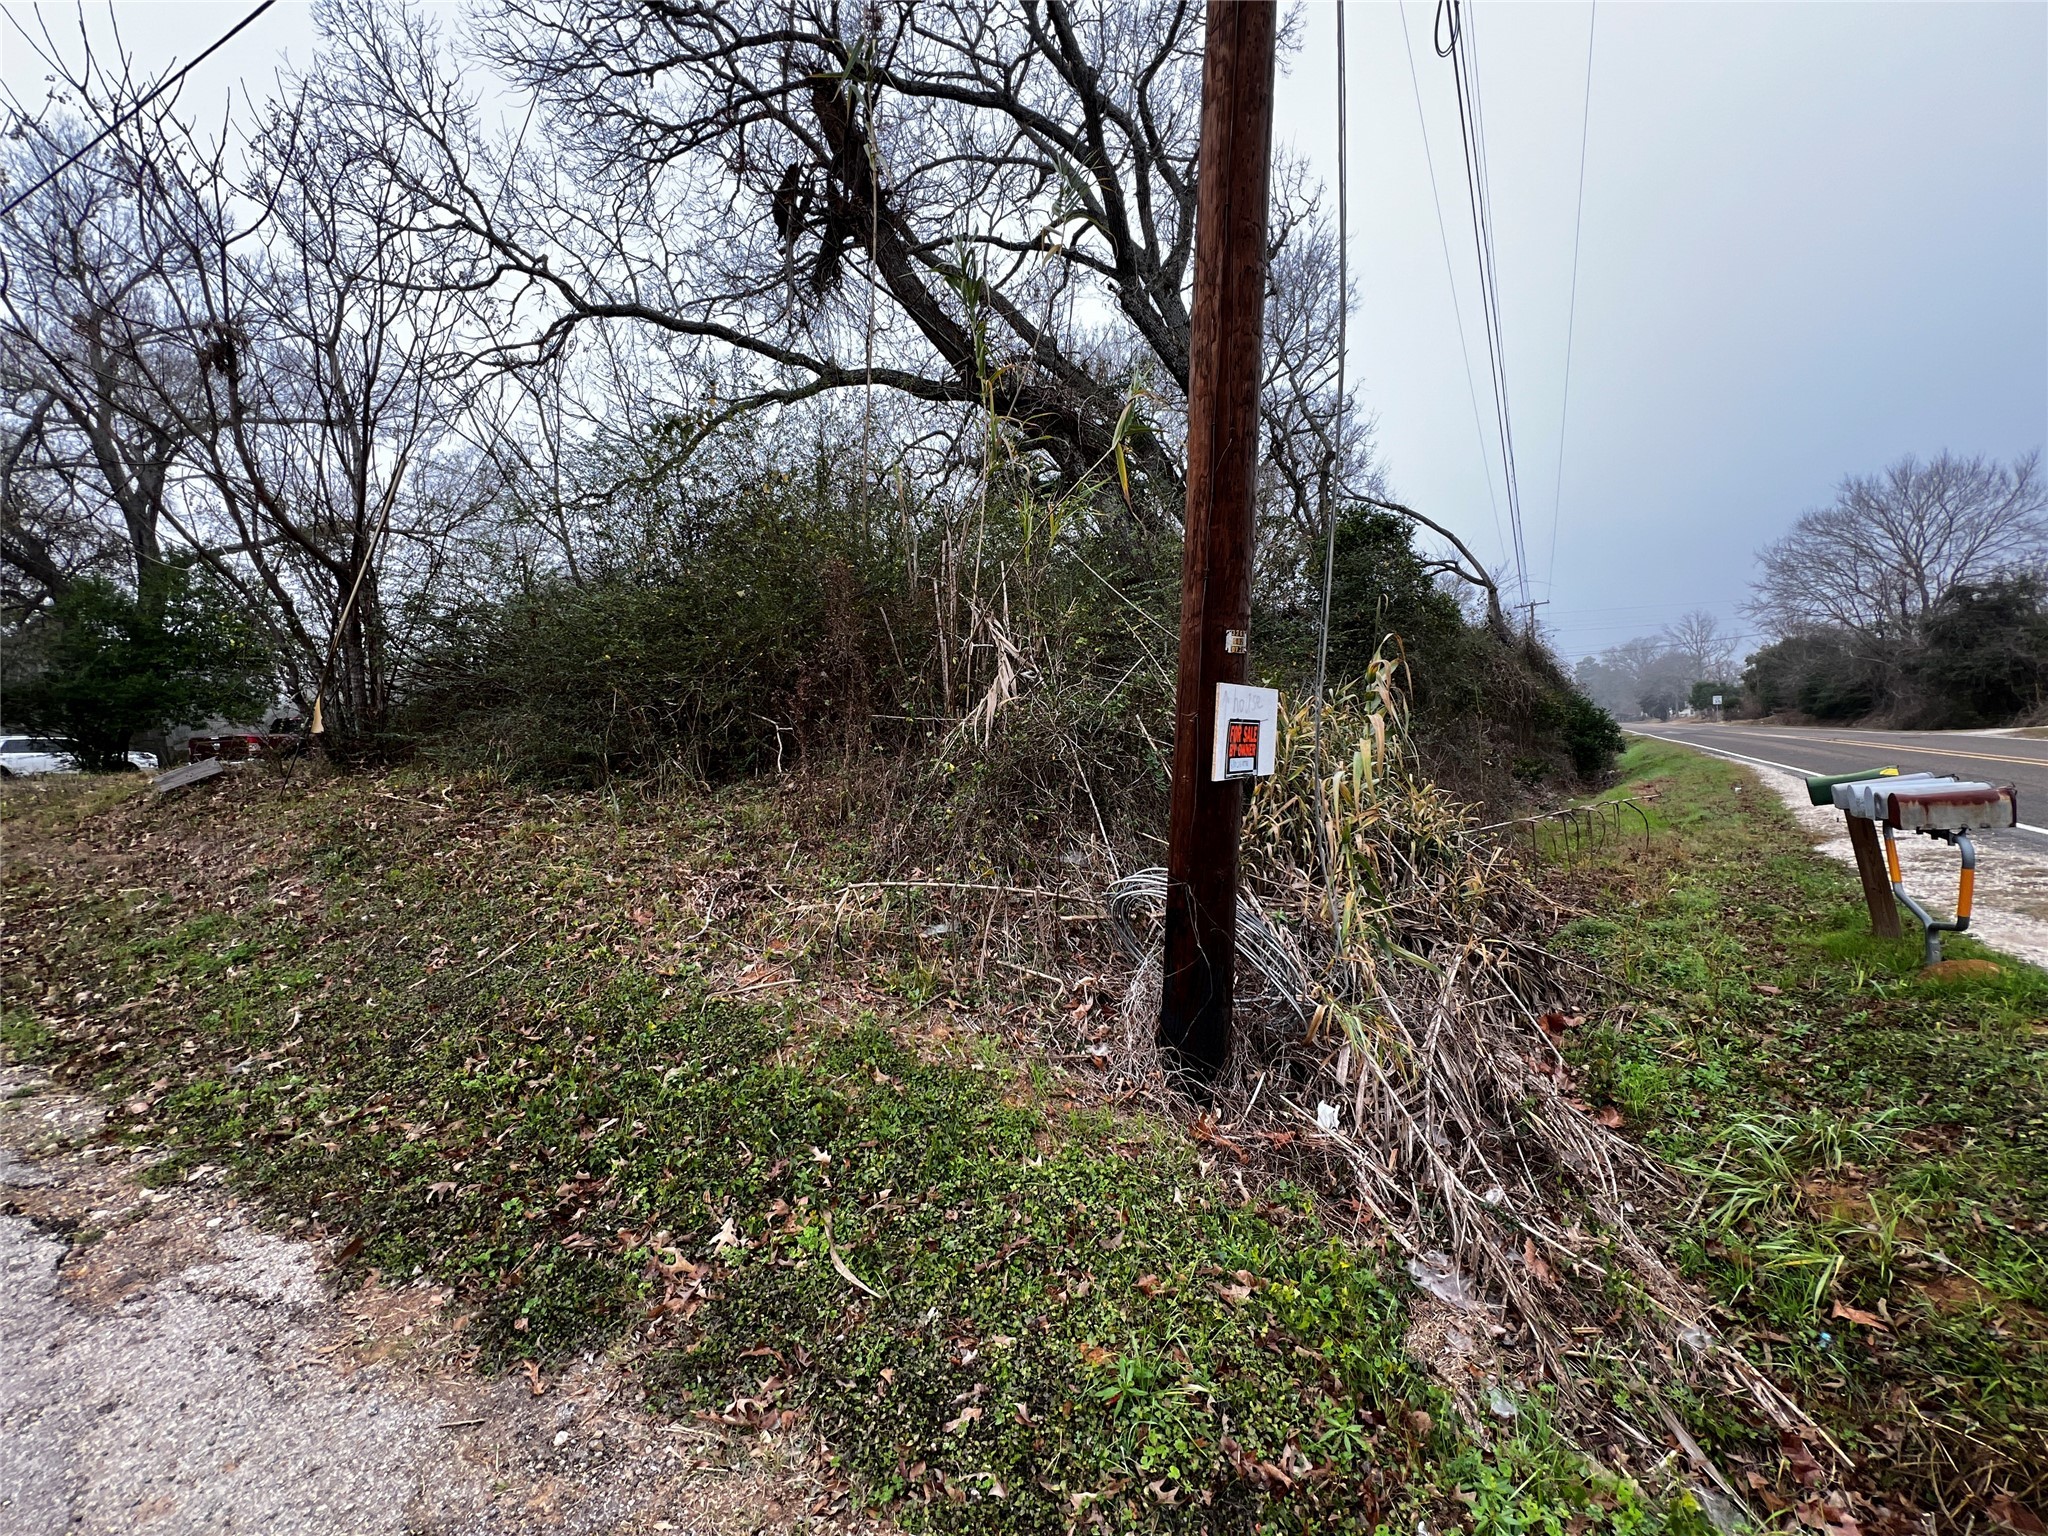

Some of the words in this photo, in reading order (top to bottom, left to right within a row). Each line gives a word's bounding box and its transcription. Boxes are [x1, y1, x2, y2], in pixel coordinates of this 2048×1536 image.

[1233, 687, 1263, 713] house
[1230, 725, 1242, 743] FOR
[1243, 726, 1258, 743] SALE
[1229, 744, 1237, 757] BY
[1238, 744, 1256, 757] OWNER
